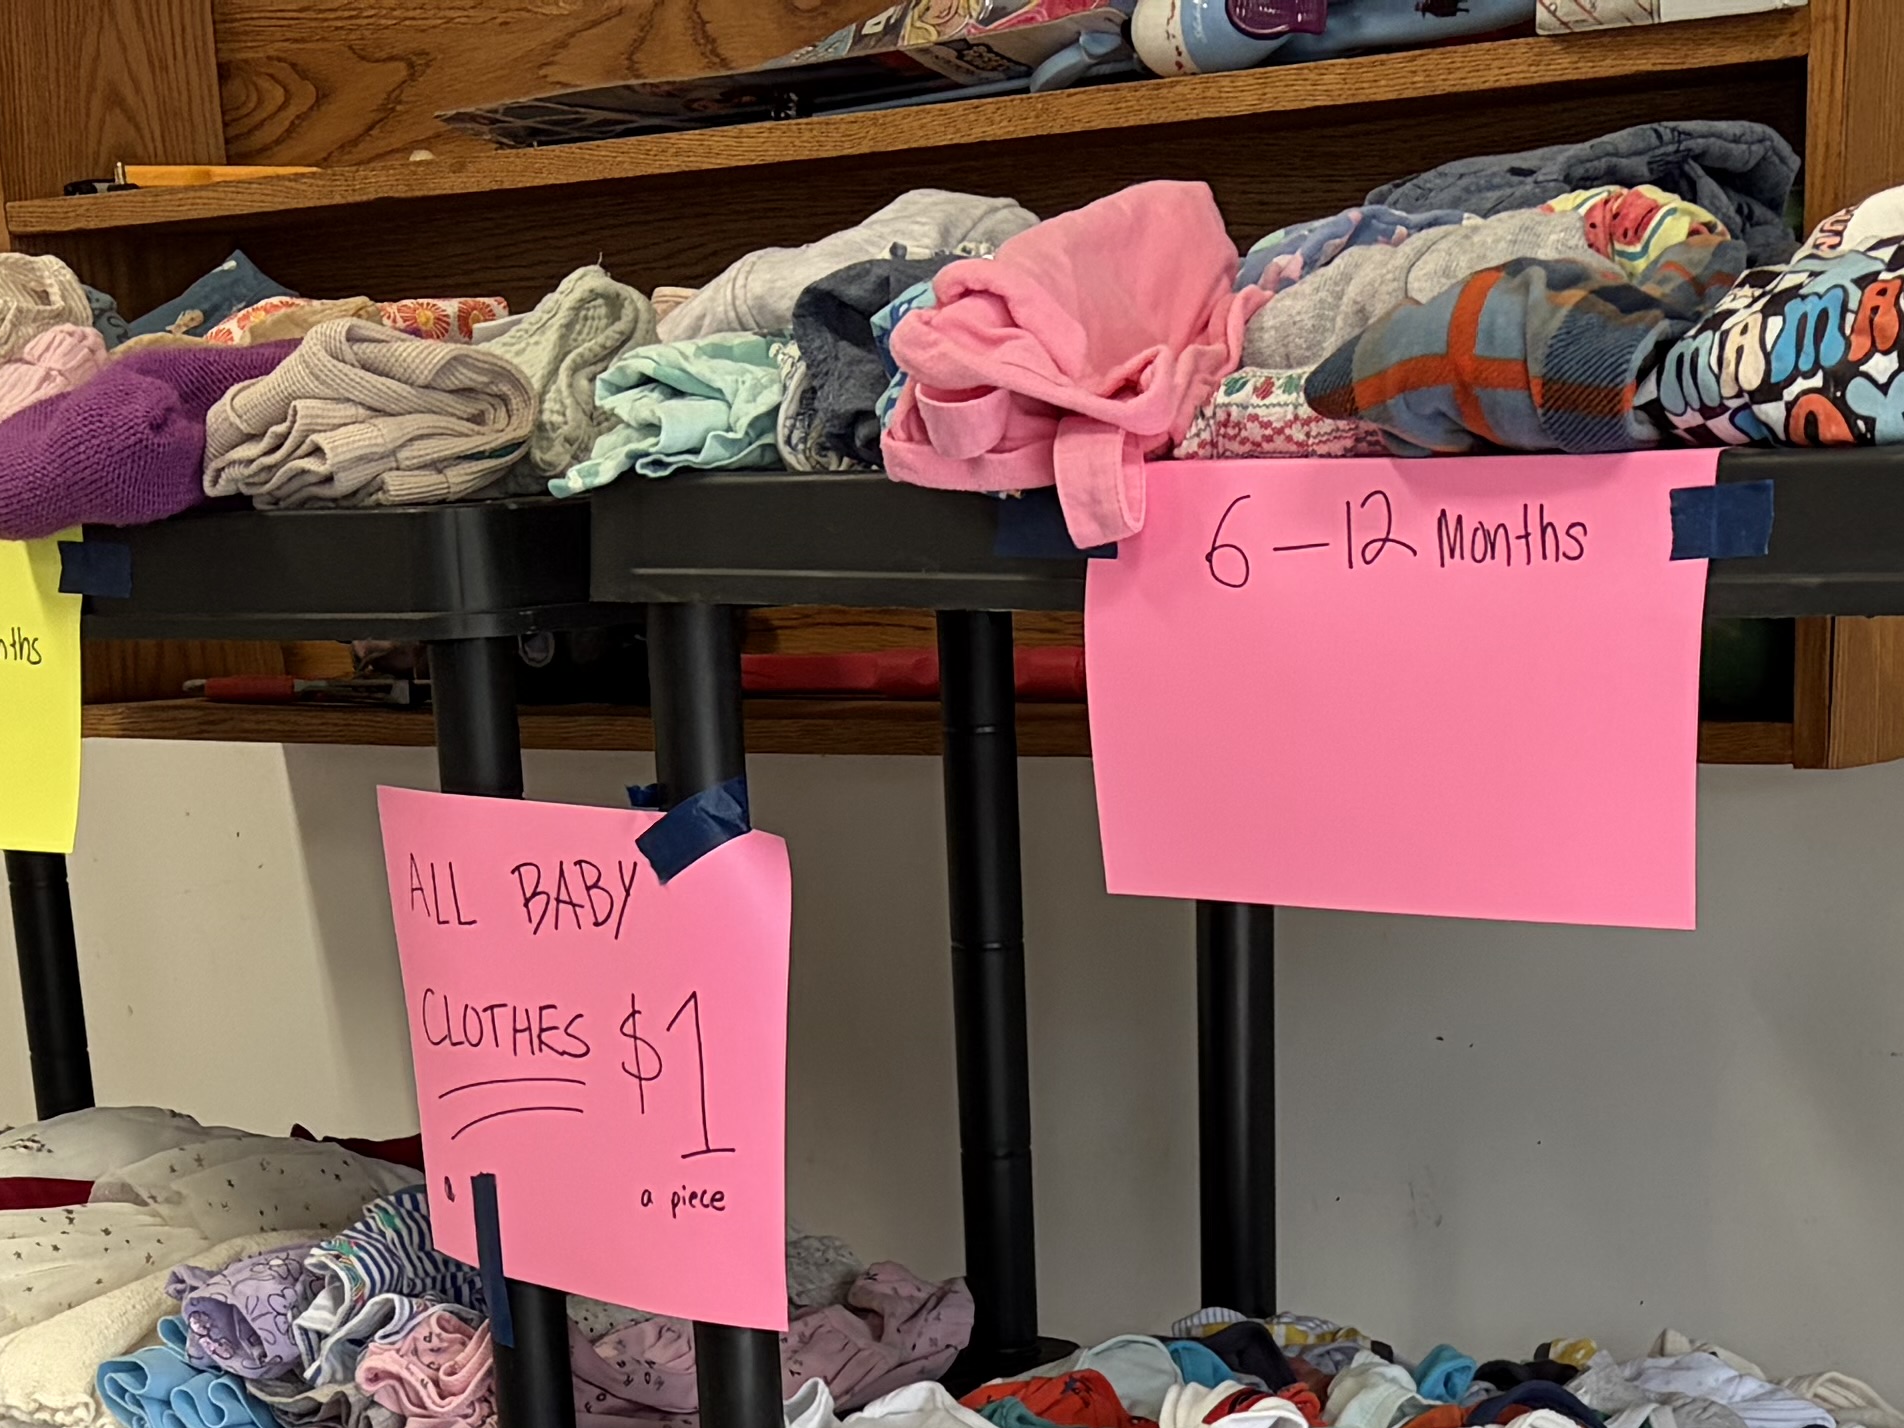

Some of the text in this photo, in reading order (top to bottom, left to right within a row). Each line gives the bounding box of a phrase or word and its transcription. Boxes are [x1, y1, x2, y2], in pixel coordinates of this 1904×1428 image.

[1436, 502, 1588, 569] Months
[409, 852, 638, 941] ALL BABY
[422, 987, 737, 1160] CLOTHES $1
[640, 1184, 726, 1220] a piece
